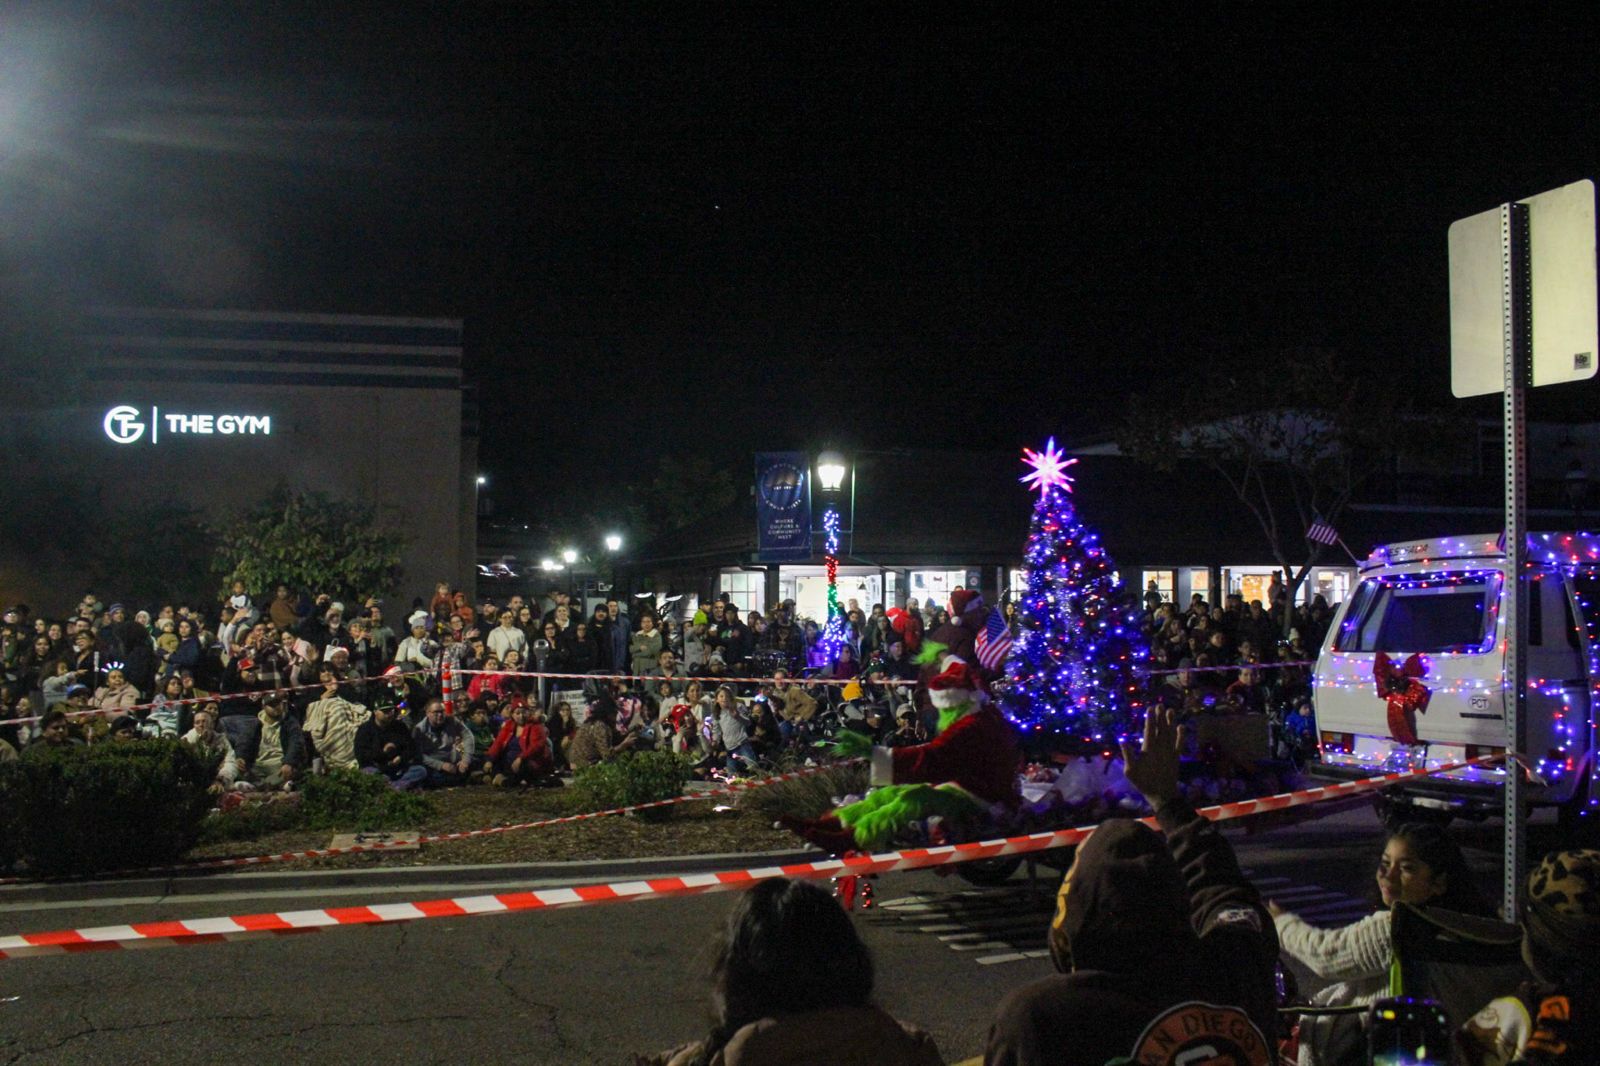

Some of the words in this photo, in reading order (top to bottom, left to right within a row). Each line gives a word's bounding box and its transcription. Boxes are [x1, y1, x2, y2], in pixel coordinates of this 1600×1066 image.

[165, 414, 213, 434] THE
[217, 415, 271, 435] GYM
[1471, 697, 1488, 709] PCT
[1181, 1013, 1255, 1051] DIEGO
